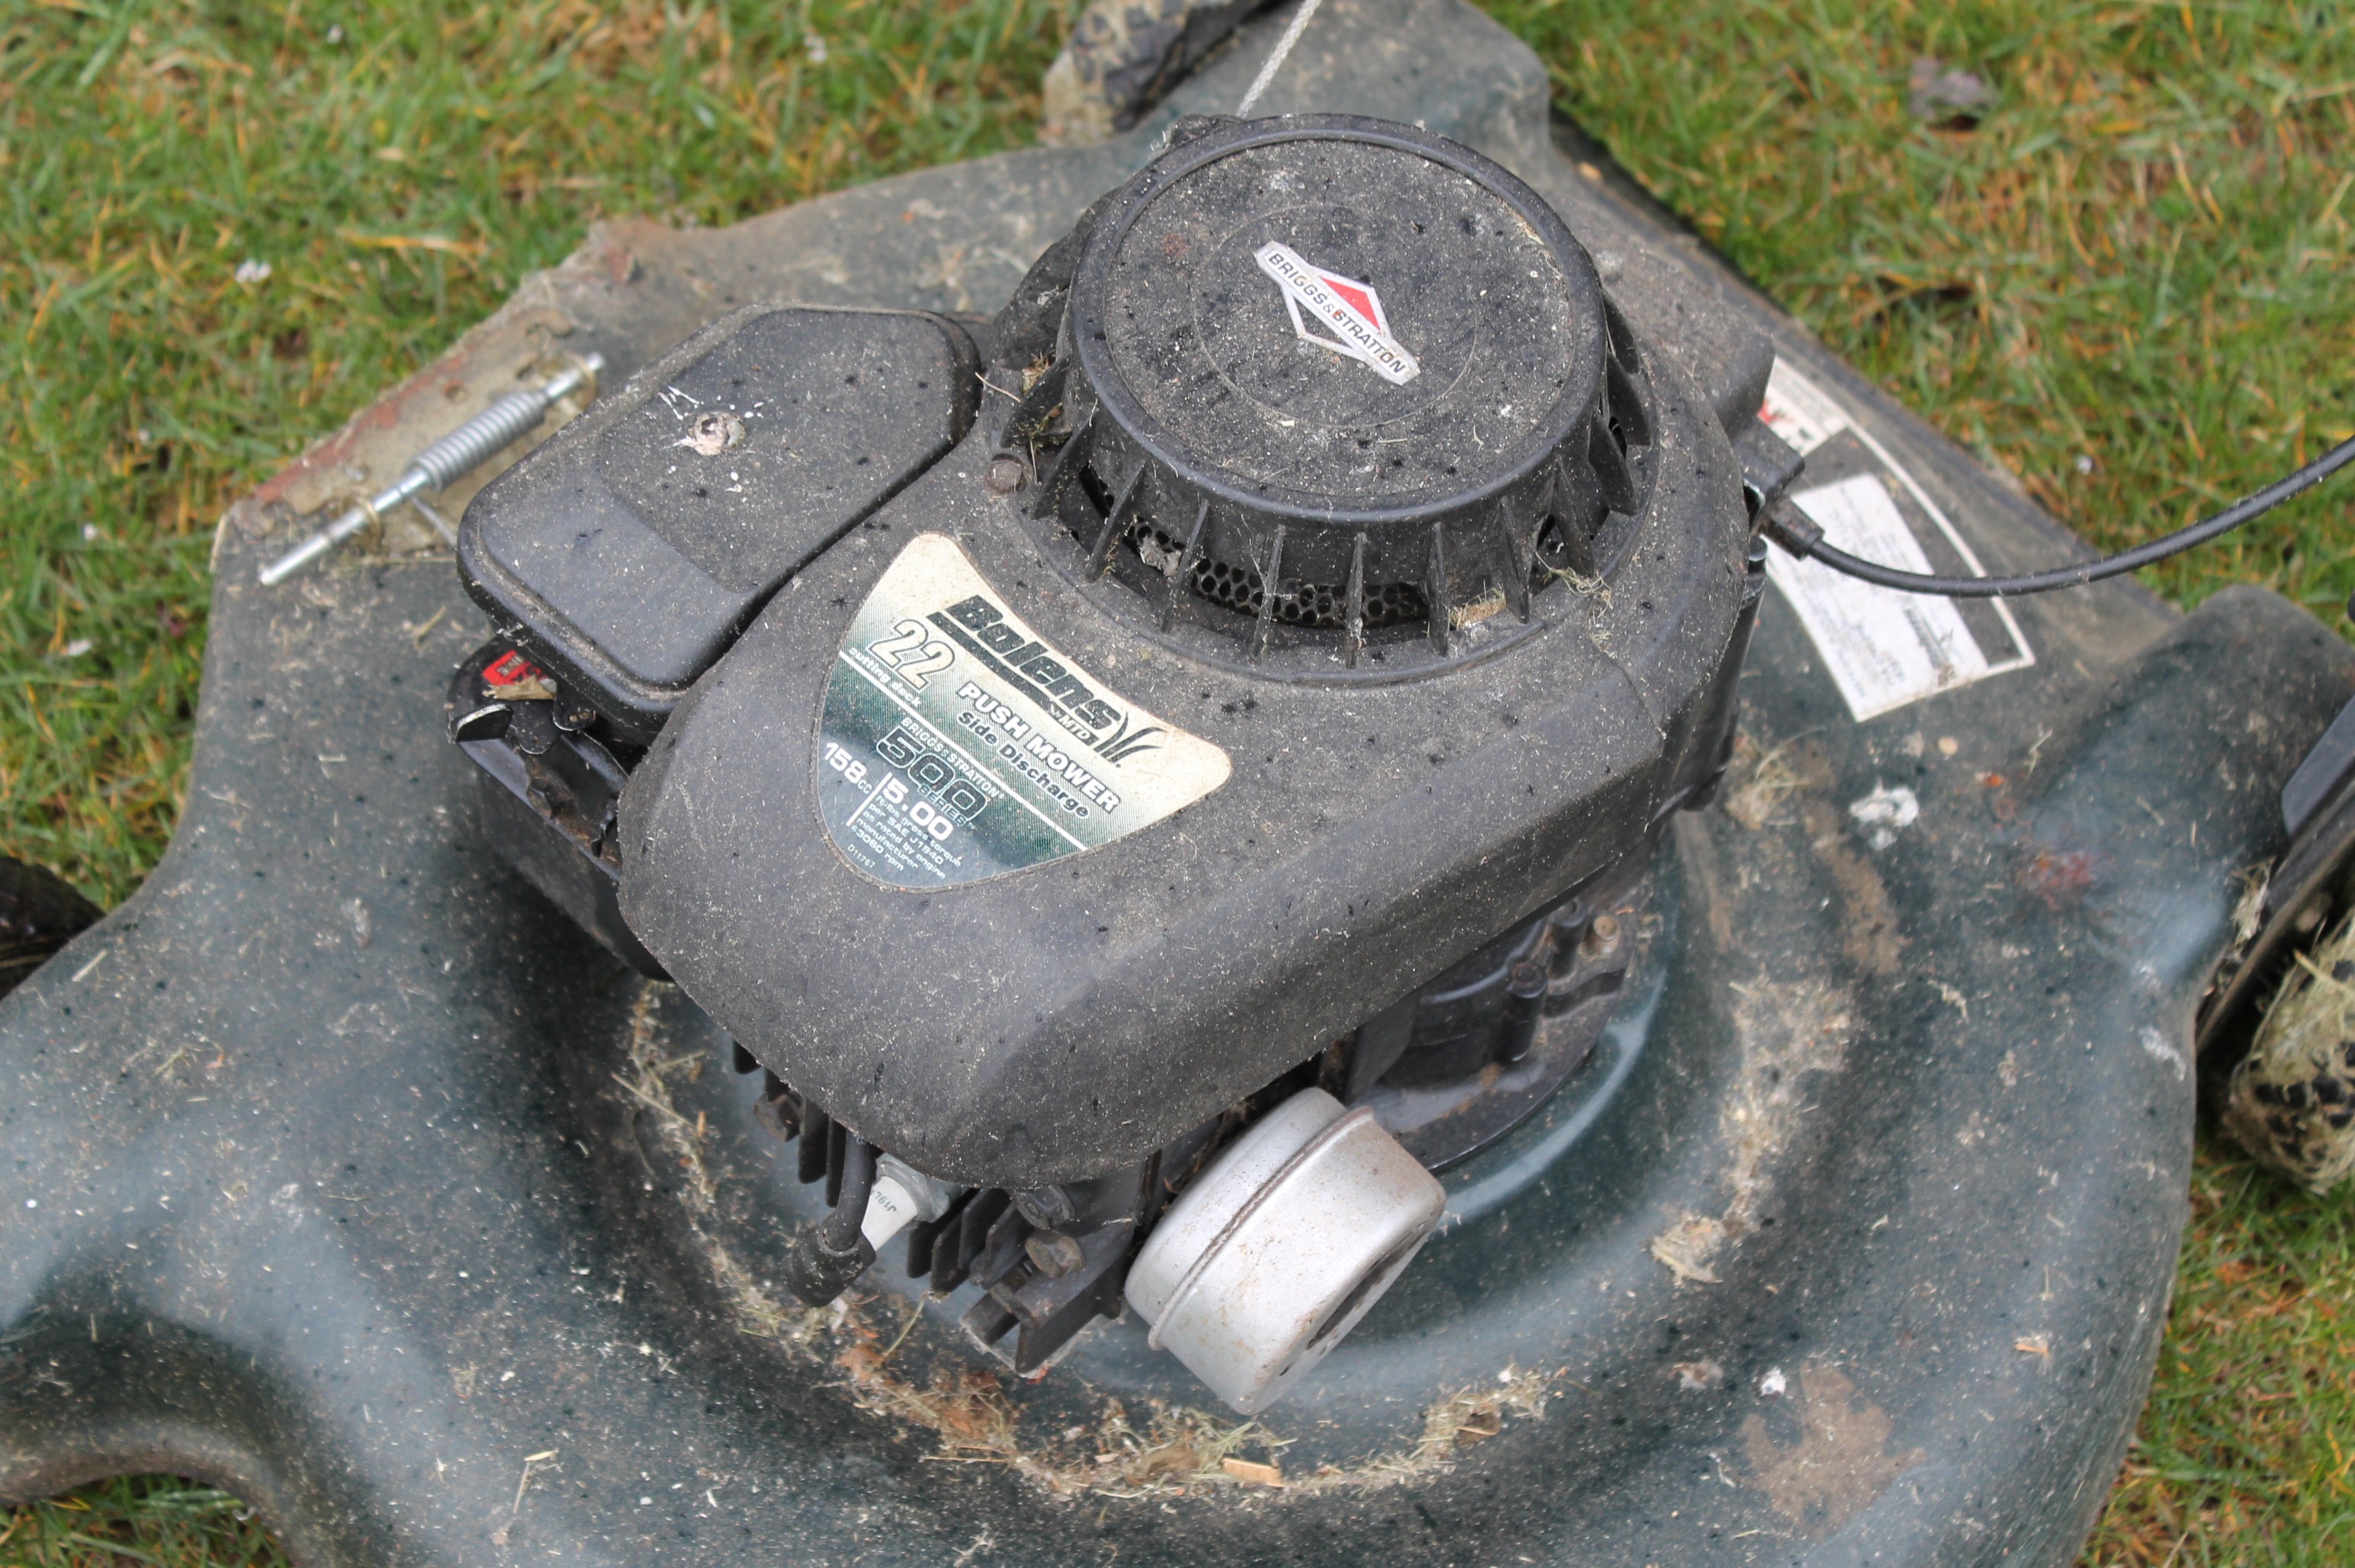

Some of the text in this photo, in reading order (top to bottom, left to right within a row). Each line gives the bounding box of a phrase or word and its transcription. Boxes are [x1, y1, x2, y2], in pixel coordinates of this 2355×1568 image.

[848, 647, 921, 708] cutting deck
[868, 619, 956, 692] 22
[946, 595, 1122, 730] Bolens
[956, 680, 1121, 814] PUSH MOWER
[1058, 714, 1091, 740] MTD
[876, 725, 987, 821] 500
[958, 712, 1088, 818] Side Discharge
[868, 803, 943, 865] per SAE J1940
[882, 778, 953, 840] 5.00
[847, 843, 875, 869] D11767
[856, 818, 918, 869] manufacturer
[863, 811, 946, 879] as rated by engine
[885, 852, 904, 871] rpm
[901, 818, 928, 840] gross
[930, 840, 961, 867] torque
